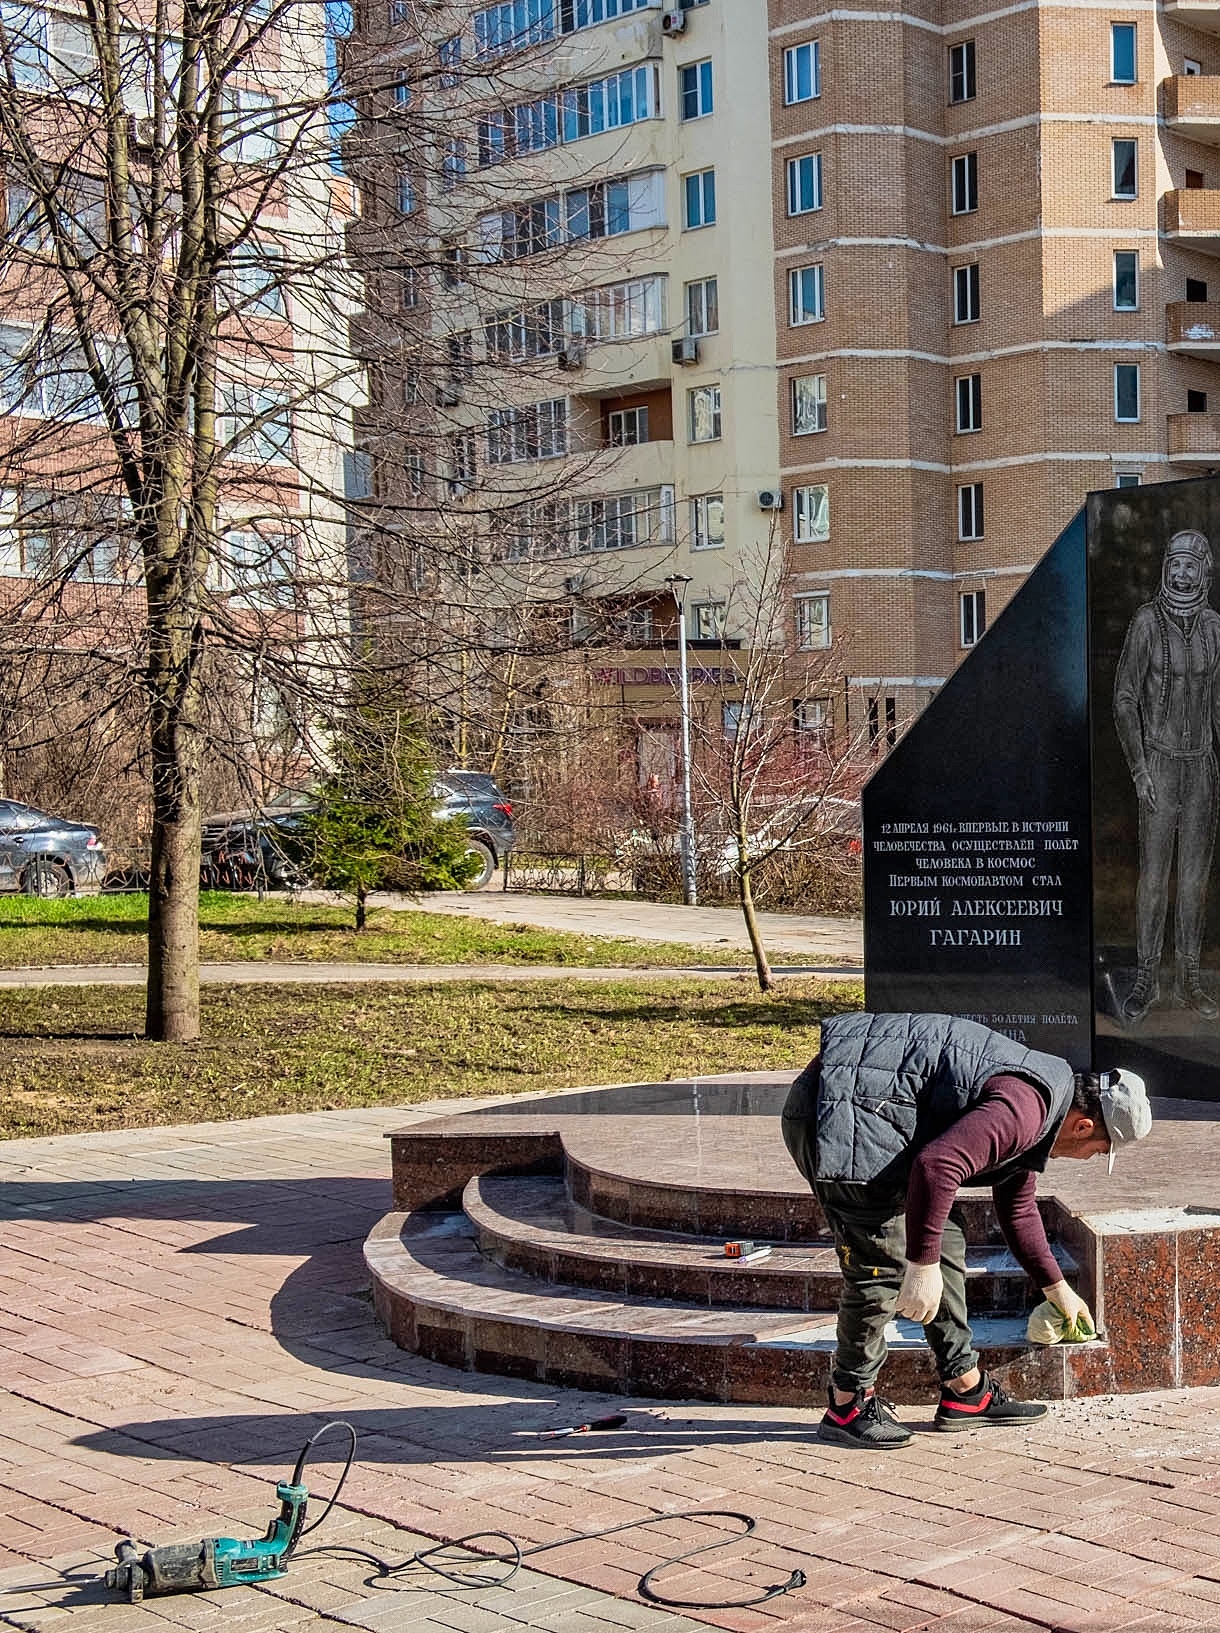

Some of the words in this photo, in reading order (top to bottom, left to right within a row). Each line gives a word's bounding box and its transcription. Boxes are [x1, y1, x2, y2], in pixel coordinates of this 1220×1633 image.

[881, 823, 892, 834] 12
[892, 822, 929, 834] АПРЕЛЯ
[958, 821, 1010, 833] ВПЕРВЫЕ
[1012, 821, 1020, 833] В
[1021, 821, 1069, 833] ИСТОРИИ
[873, 840, 946, 852] ЧЕЛОВЕЧЕСТВА
[951, 839, 1035, 852] ОСУЩЕСТВЛЕН
[915, 857, 972, 869] ЧЕЛОВЕКА
[976, 857, 985, 869] В
[987, 857, 1036, 869] КОСМОС
[942, 874, 1024, 886] КОСМОНАВТОМ
[1031, 874, 1062, 886] СТАЛ
[889, 897, 941, 916] ЮРИЙ
[951, 900, 1064, 916] АЛЕКСЕЕВИЧ
[929, 929, 1022, 946] ГАГАРИН
